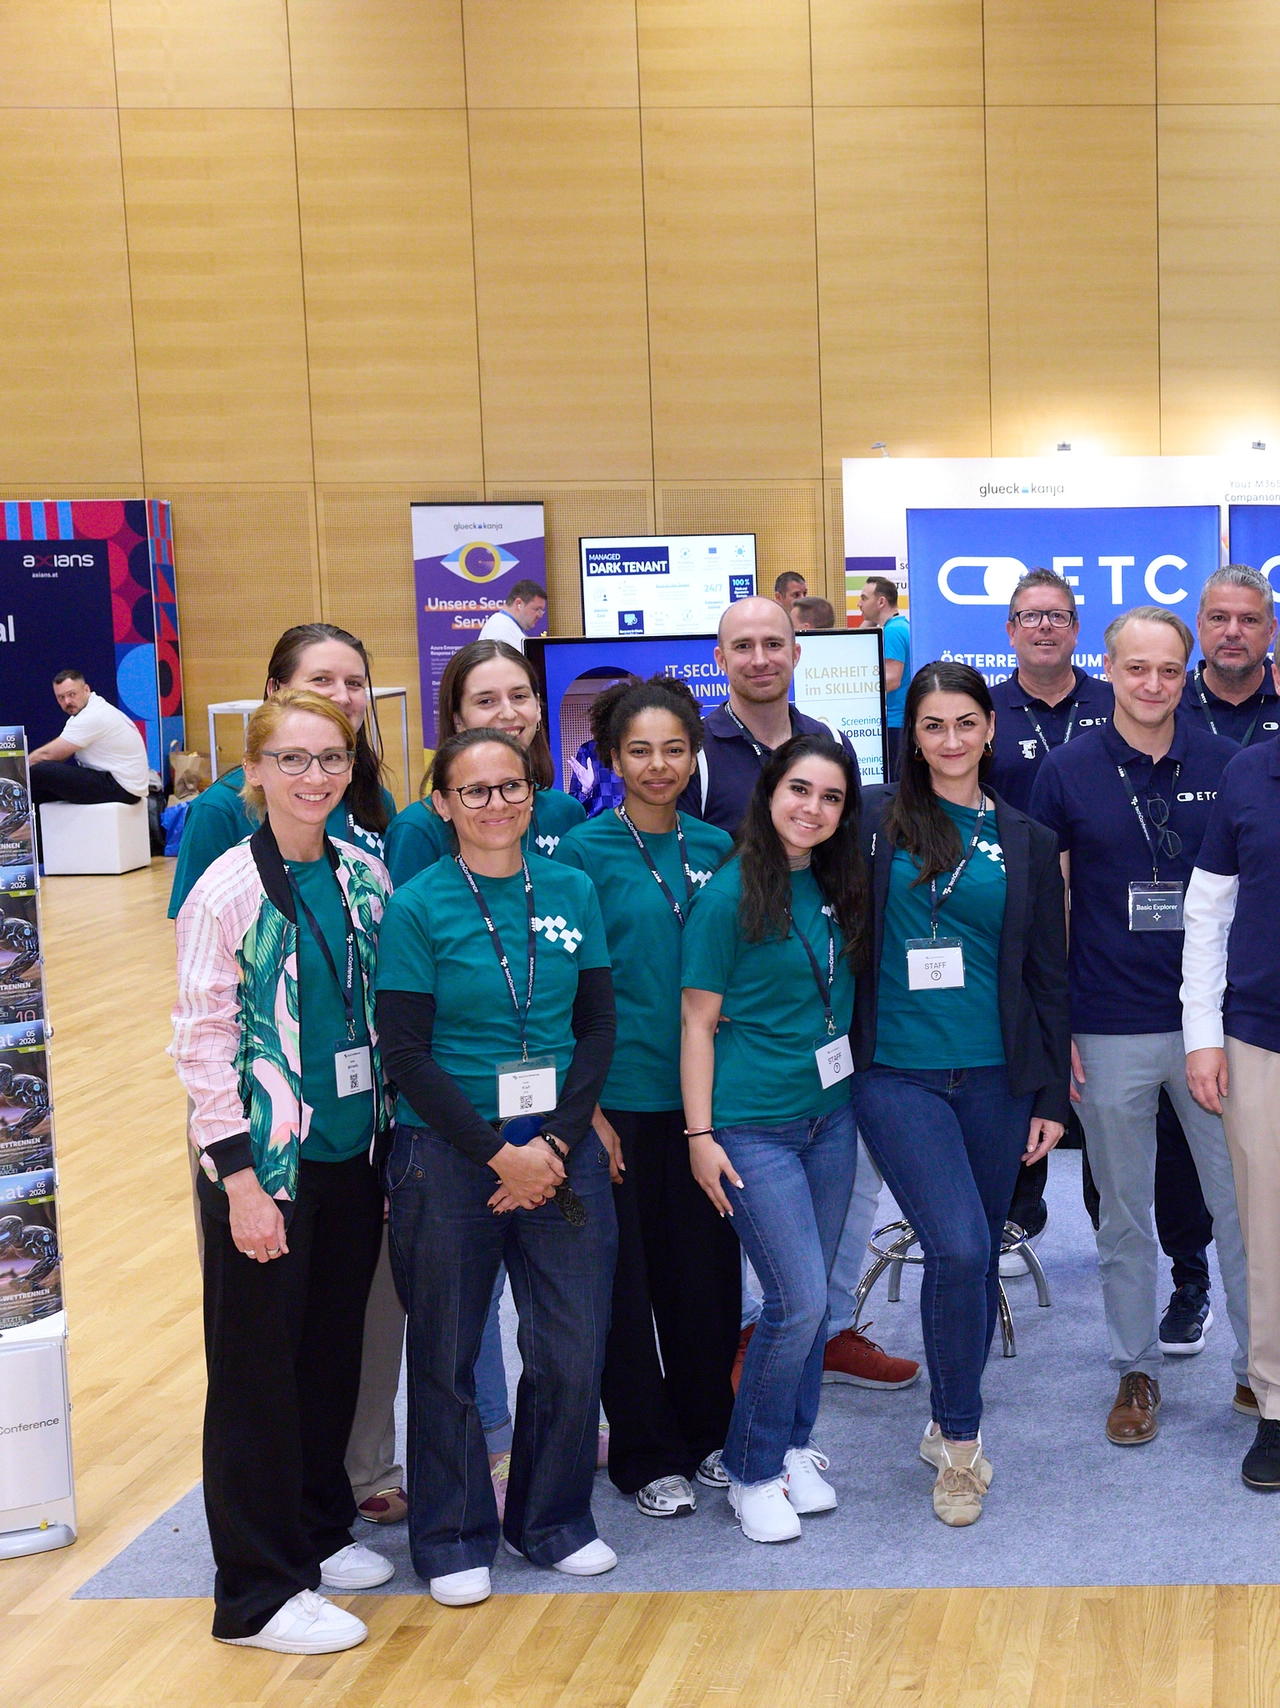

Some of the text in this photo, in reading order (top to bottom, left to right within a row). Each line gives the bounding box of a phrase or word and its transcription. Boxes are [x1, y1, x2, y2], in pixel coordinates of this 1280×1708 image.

[979, 483, 1065, 498] glueck kanja
[453, 522, 503, 531] glueck kanja
[23, 554, 94, 568] axians
[588, 553, 621, 561] MANAGED
[589, 563, 622, 575] DARK
[622, 560, 668, 573] TENANT
[1052, 554, 1188, 605] ETC
[703, 583, 723, 593] 24/7
[427, 597, 477, 610] Unsere
[454, 614, 490, 629] Servi
[941, 650, 1018, 668] ÖSTERRE
[665, 663, 725, 678] IT-SECU
[804, 665, 869, 680] KLARHEIT
[805, 683, 822, 697] im
[840, 715, 882, 726] Screening
[10, 881, 27, 889] 2026
[1136, 902, 1178, 912] Basic Explorer
[924, 961, 947, 970] STAFF
[18, 1037, 37, 1046] 2026
[827, 1052, 842, 1065] STAFF
[29, 1188, 47, 1197] 2026
